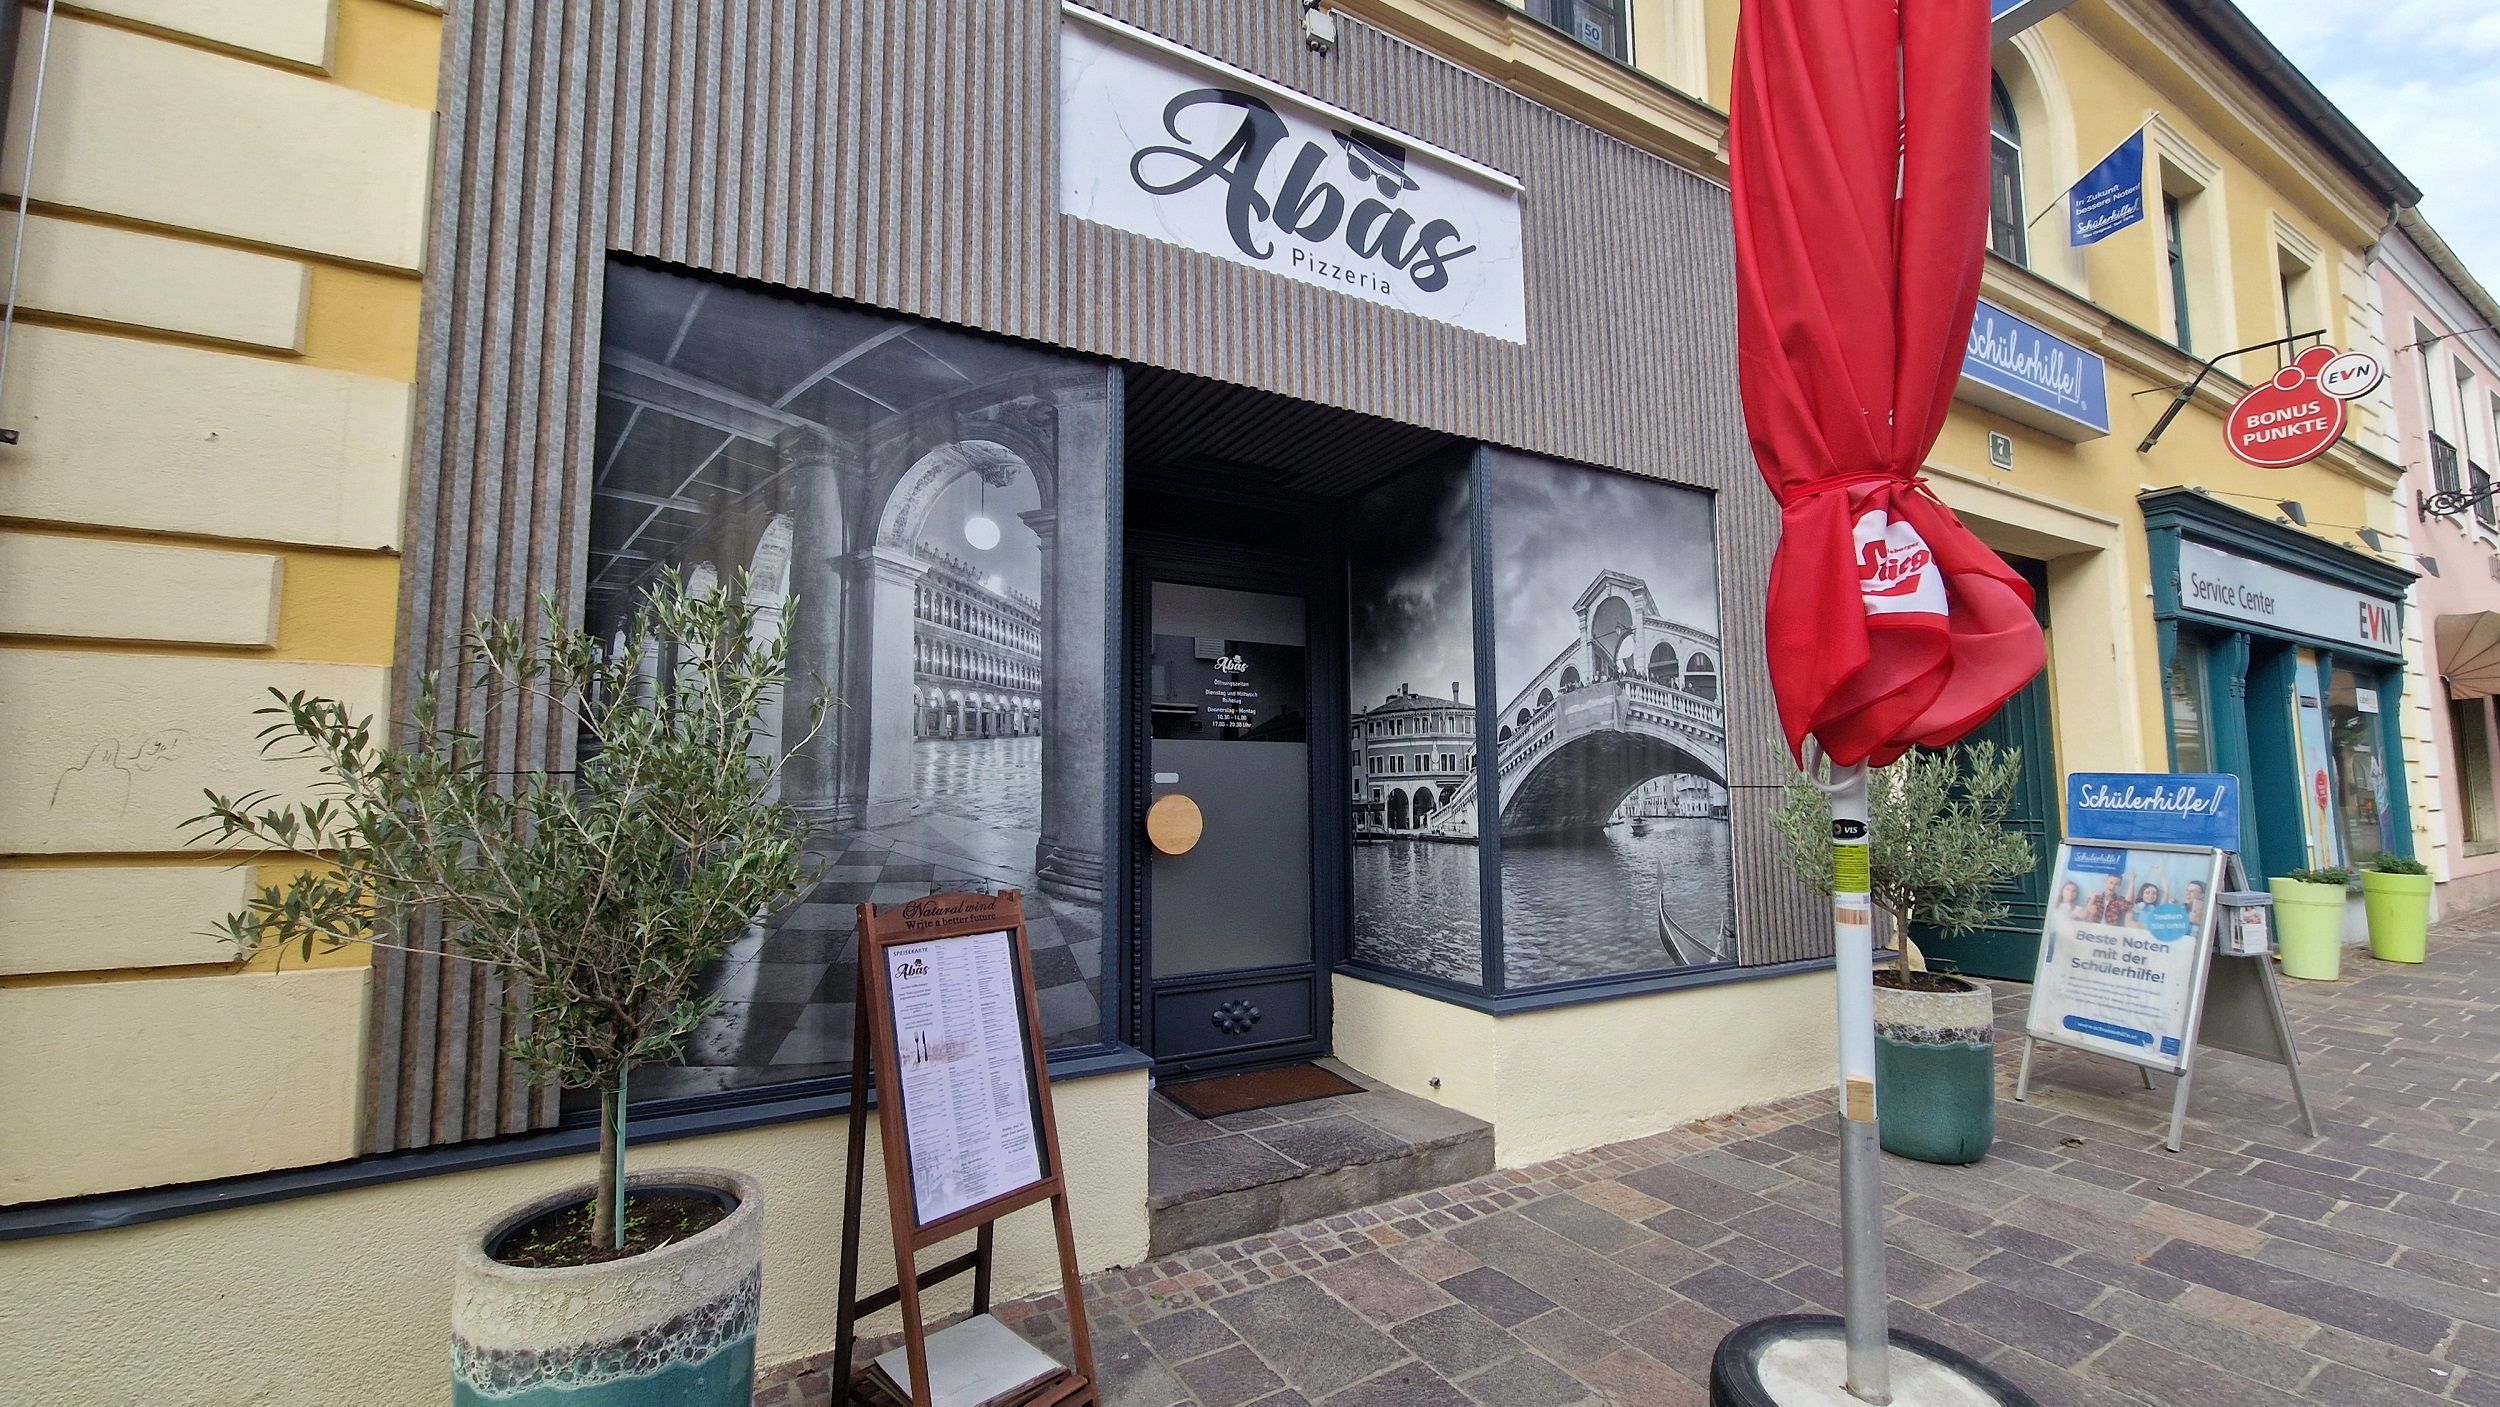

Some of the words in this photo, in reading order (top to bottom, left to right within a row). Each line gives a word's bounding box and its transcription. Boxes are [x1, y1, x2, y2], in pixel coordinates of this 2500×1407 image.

[1584, 23, 1600, 41] 50
[1130, 88, 1477, 293] Abas
[2075, 198, 2085, 208] In
[2086, 184, 2119, 202] Zukunft
[2075, 197, 2111, 216] bessere
[1291, 247, 1391, 295] Pizzeria
[2328, 364, 2370, 384] EVN
[2247, 400, 2321, 429] BONUS
[2243, 417, 2328, 447] PUNKTE
[2191, 572, 2235, 606] Service
[2238, 585, 2275, 615] Center
[2359, 600, 2392, 645] EVN
[1214, 656, 1248, 673] Abas
[2078, 783, 2226, 820] Schülerhilfe!
[1844, 826, 1859, 834] VIS
[902, 900, 964, 920] Natural
[964, 901, 996, 914] wind
[905, 919, 934, 931] Write
[935, 919, 941, 927] a
[942, 915, 969, 927] better
[970, 912, 997, 924] future
[2075, 929, 2118, 946] Beste
[2122, 936, 2170, 954] Noten
[2093, 947, 2118, 961] mit
[2121, 951, 2147, 965] der
[2071, 957, 2165, 984] Schülerhilfe!
